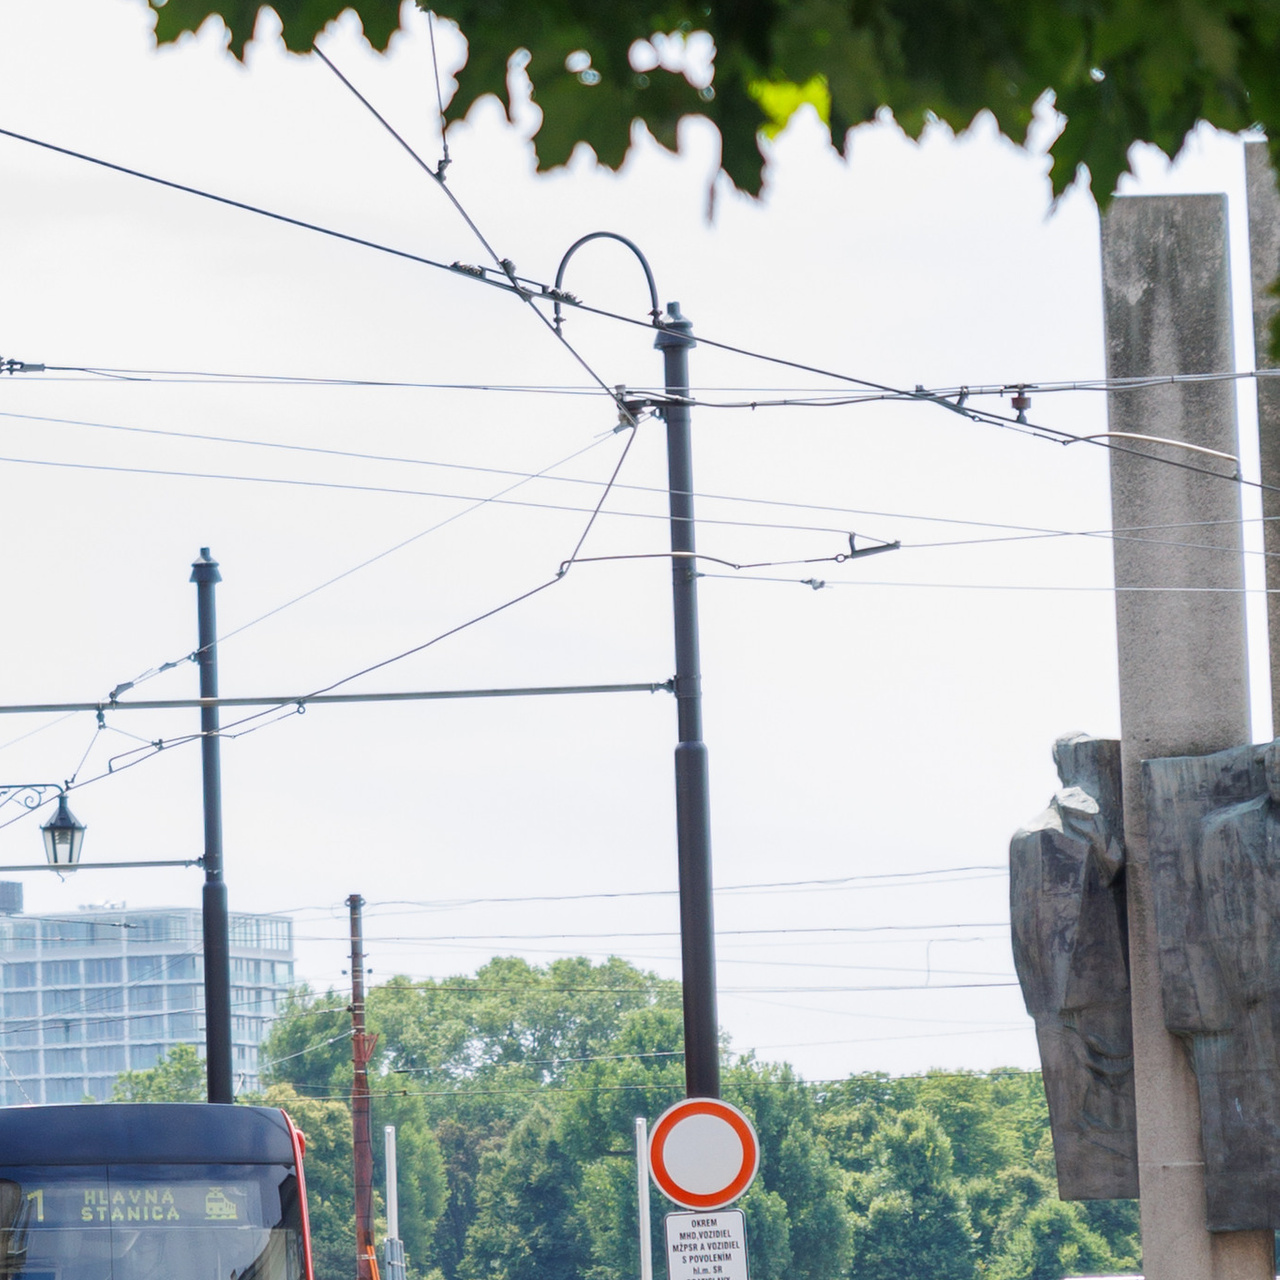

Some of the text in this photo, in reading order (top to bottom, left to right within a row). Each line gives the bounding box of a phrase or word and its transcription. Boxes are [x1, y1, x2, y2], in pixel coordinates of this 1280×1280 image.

[27, 1189, 44, 1222] 1
[81, 1206, 180, 1222] STANICA
[691, 1219, 717, 1228] OKREM
[700, 1243, 705, 1251] A
[707, 1240, 740, 1251] VOZIDIEL
[682, 1255, 687, 1264] S
[713, 1266, 722, 1274] SR
